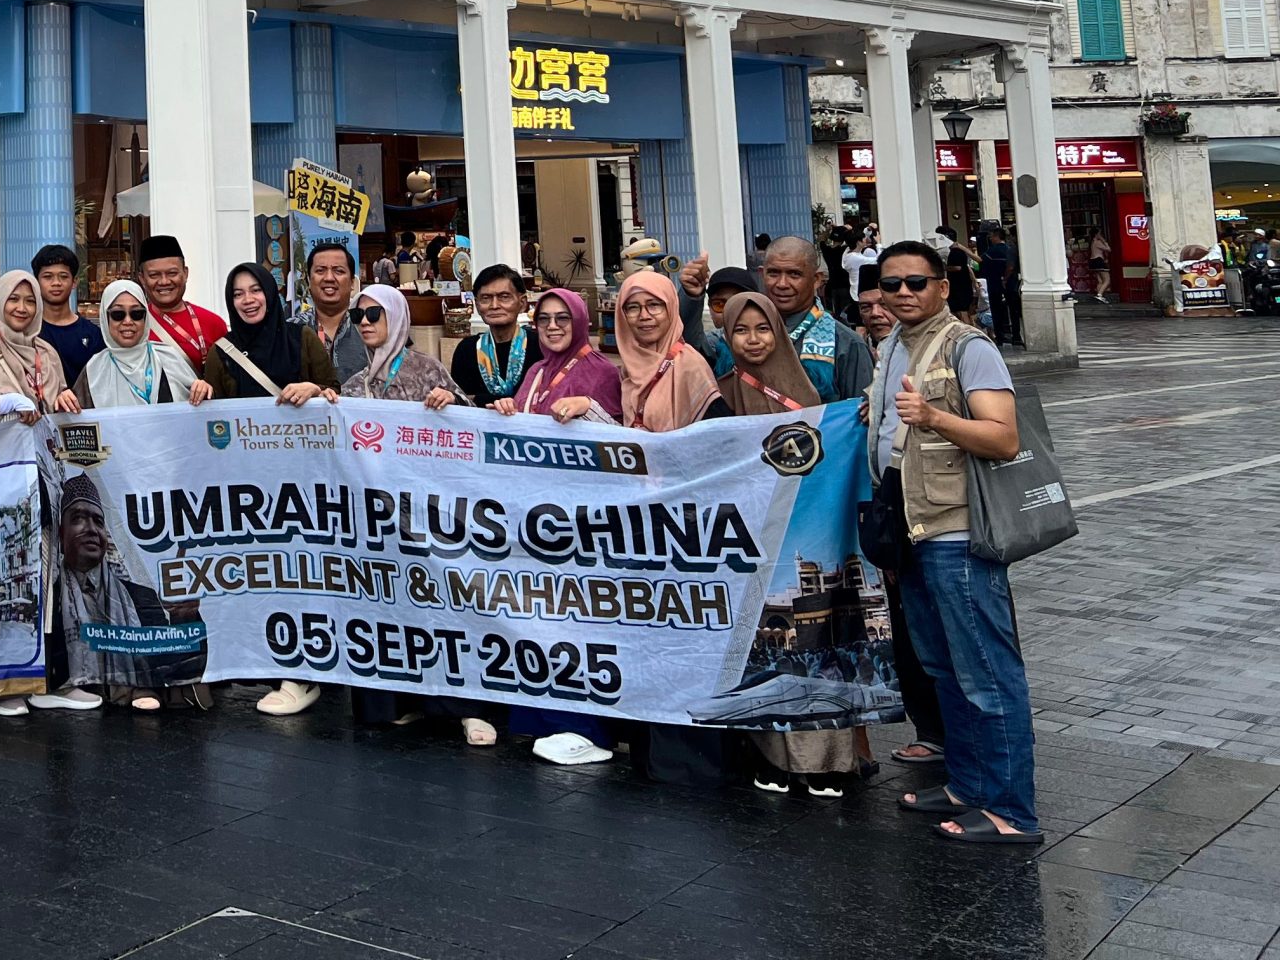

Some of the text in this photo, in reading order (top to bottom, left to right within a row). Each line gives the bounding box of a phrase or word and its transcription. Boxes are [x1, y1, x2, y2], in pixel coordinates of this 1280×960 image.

[509, 47, 610, 101] 边宫宫
[1057, 144, 1101, 166] 特产
[302, 161, 350, 185] PURELY HAINAN
[296, 171, 311, 210] 这很
[310, 178, 363, 231] 海南
[65, 429, 94, 437] TRAVEL
[235, 416, 338, 437] khazzanah
[395, 425, 475, 450] 海南航空
[239, 437, 335, 451] Tours & Travel
[395, 447, 474, 461] HAINAN AIRLINES
[493, 436, 637, 471] KLOTER 16
[124, 482, 762, 560] UMRAH PLUS CHINA
[159, 553, 731, 626] EXCELLENT & MAHABBAH
[86, 627, 200, 642] Ust. H. Zainul Arifin, Lc
[265, 611, 622, 692] 05 SEPT 2025
